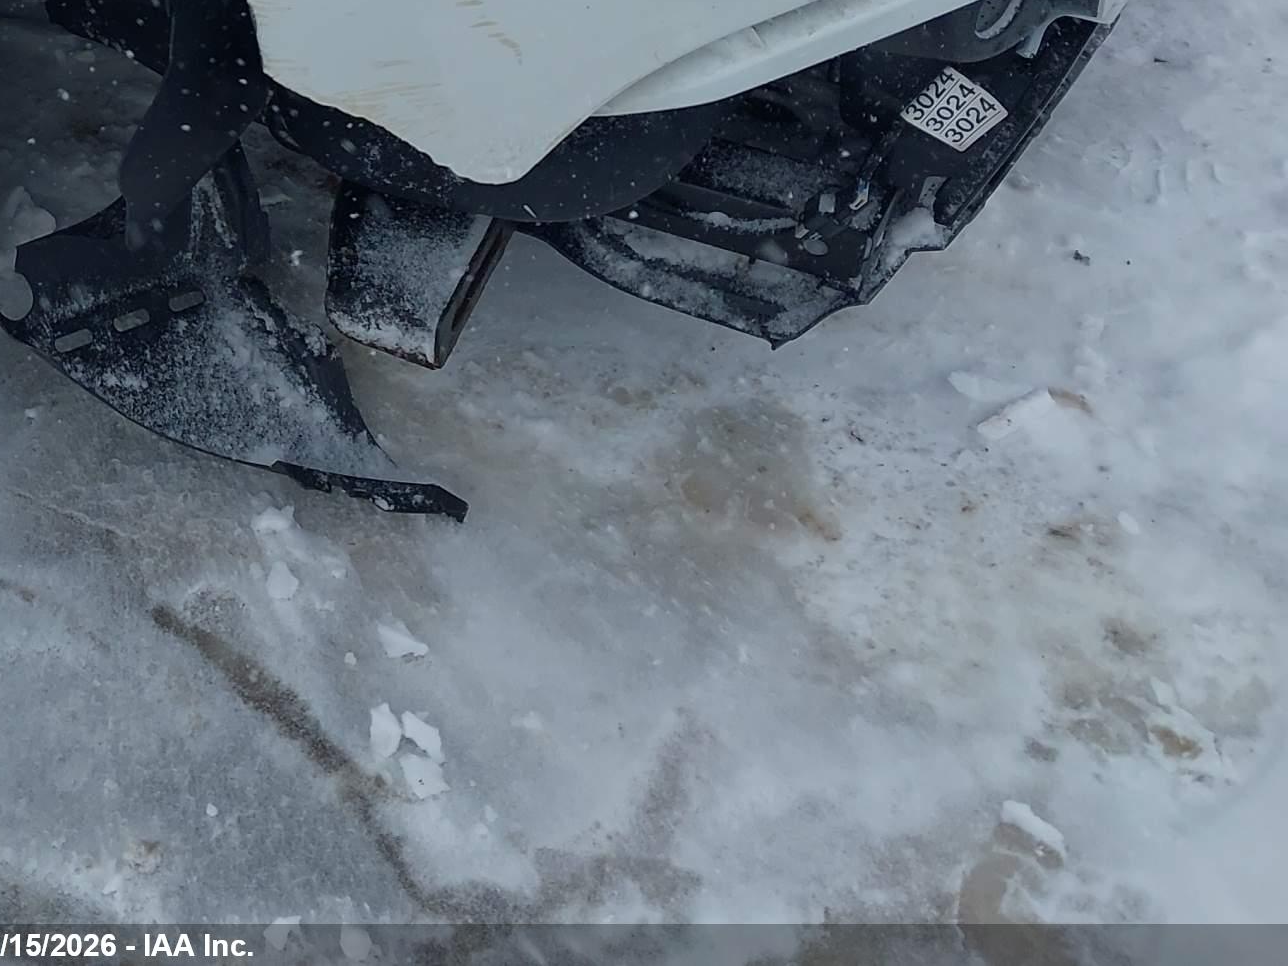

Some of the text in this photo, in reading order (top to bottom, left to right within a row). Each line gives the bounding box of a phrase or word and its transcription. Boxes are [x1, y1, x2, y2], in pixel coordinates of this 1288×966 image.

[906, 72, 955, 121] 3024
[926, 84, 976, 132] 3024
[944, 97, 998, 143] 3024
